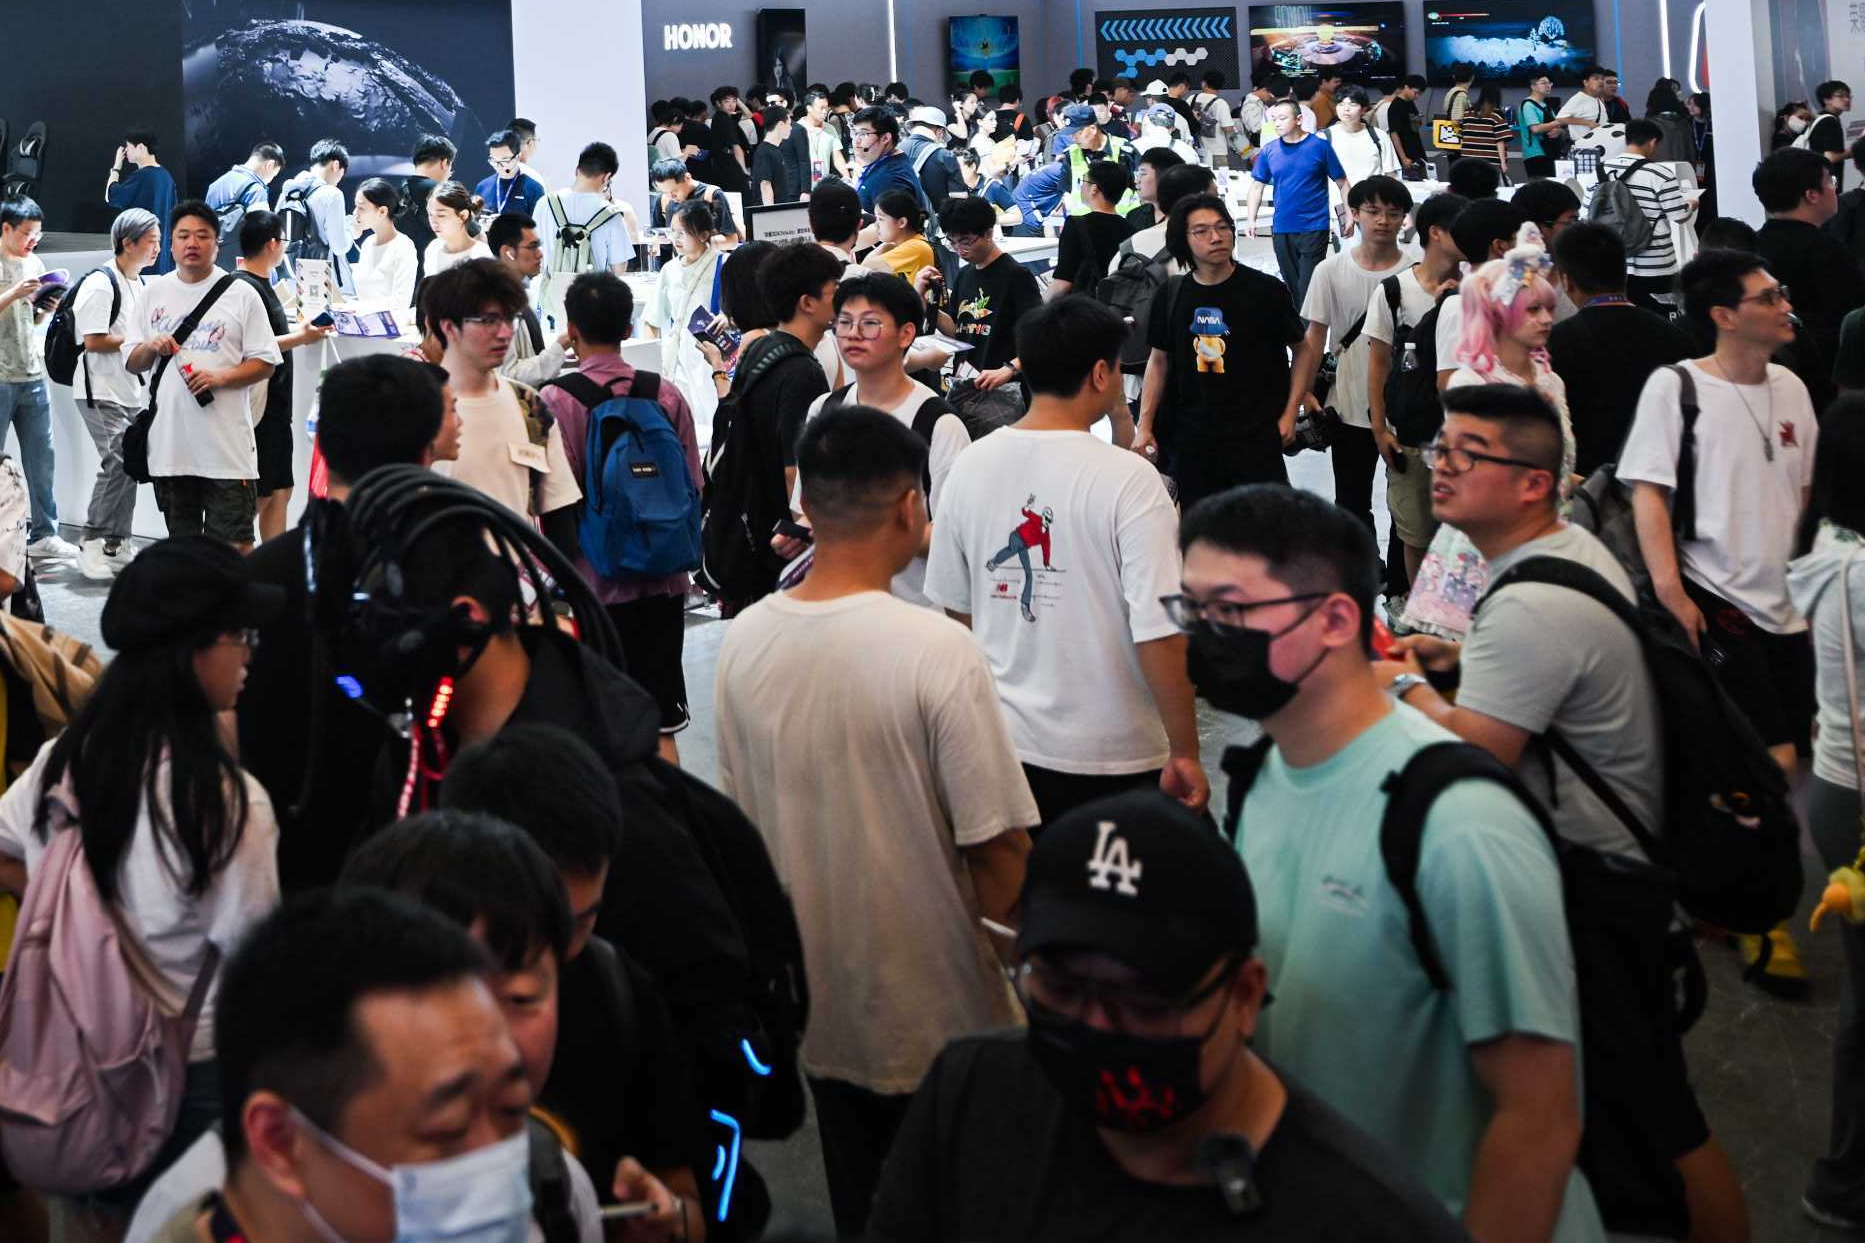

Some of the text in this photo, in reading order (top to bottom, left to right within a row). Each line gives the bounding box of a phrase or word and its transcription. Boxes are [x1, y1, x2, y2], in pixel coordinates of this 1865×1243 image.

[664, 22, 733, 51] HONOR
[1197, 316, 1221, 325] NASA
[1087, 820, 1142, 895] LA
